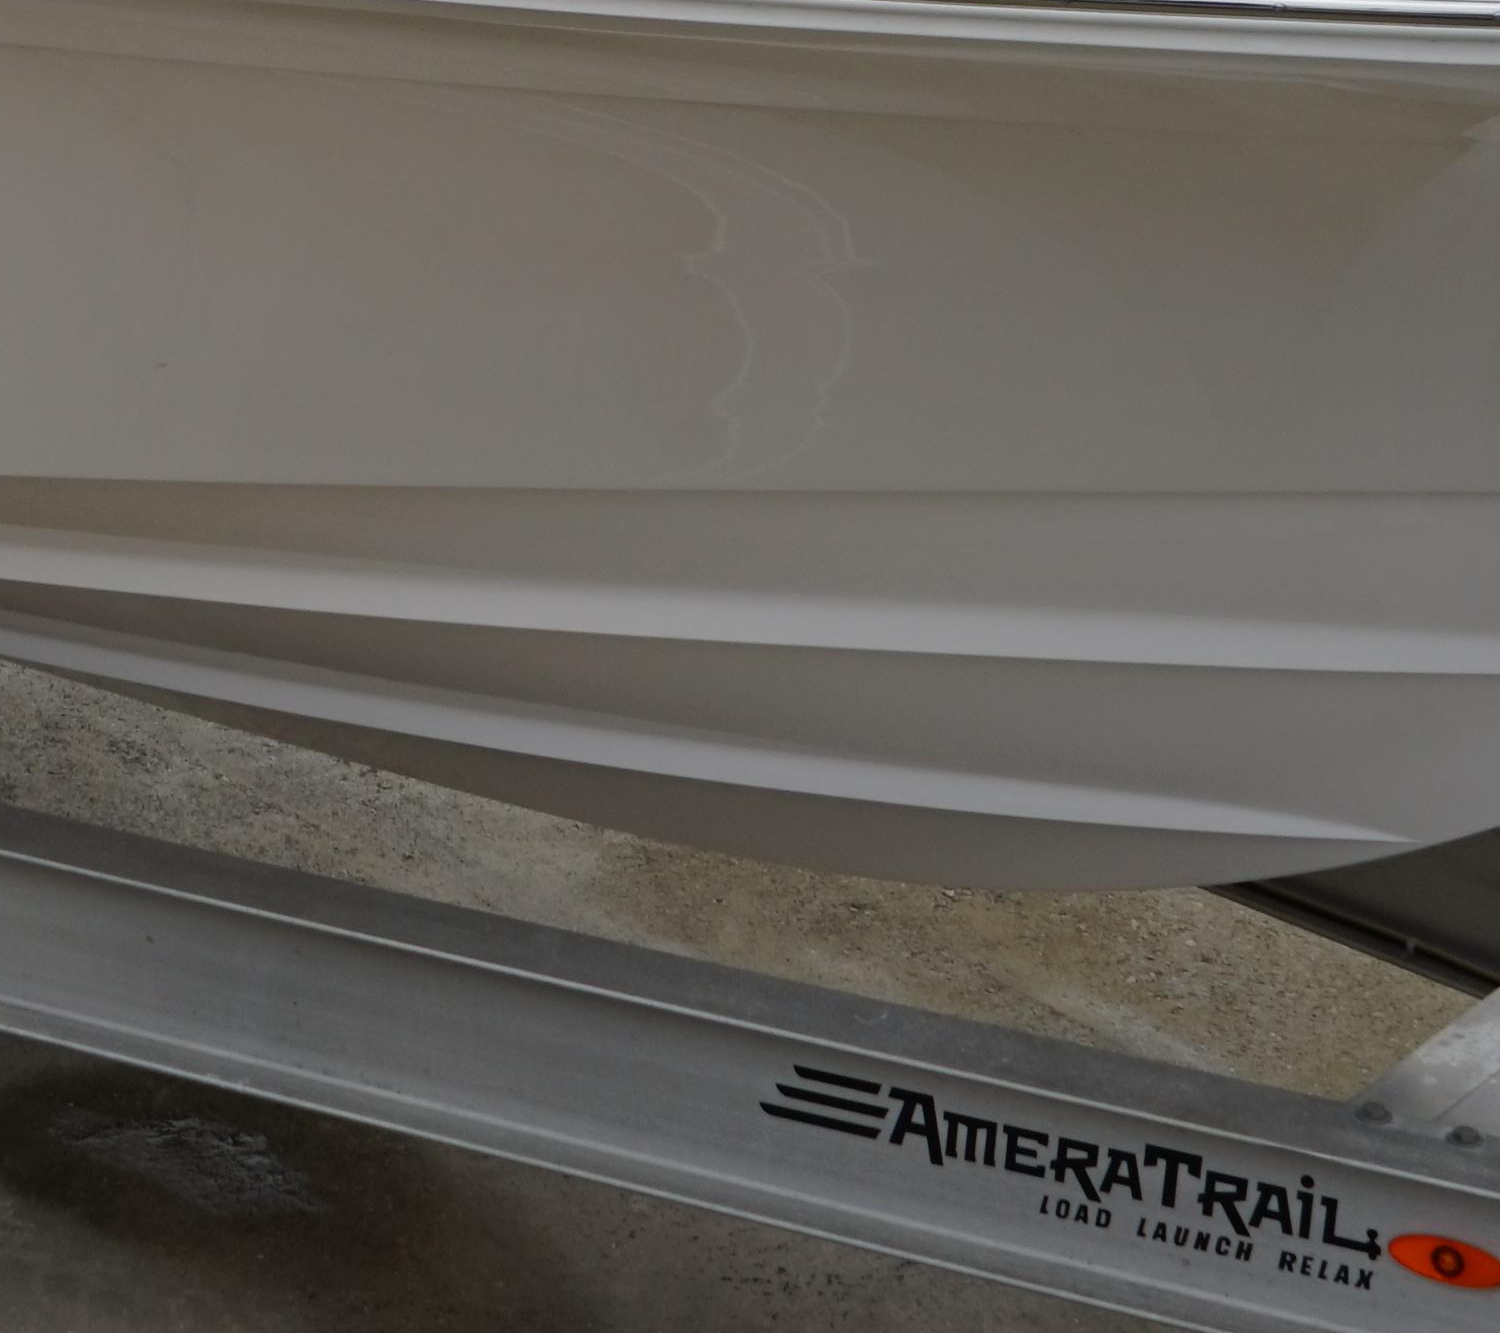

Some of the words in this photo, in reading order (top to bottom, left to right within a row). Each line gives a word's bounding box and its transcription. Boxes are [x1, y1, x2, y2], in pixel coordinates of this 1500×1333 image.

[1039, 1195, 1112, 1230] LOAD
[1137, 1217, 1253, 1262] LAUNCH
[1278, 1250, 1375, 1291] RELAX
